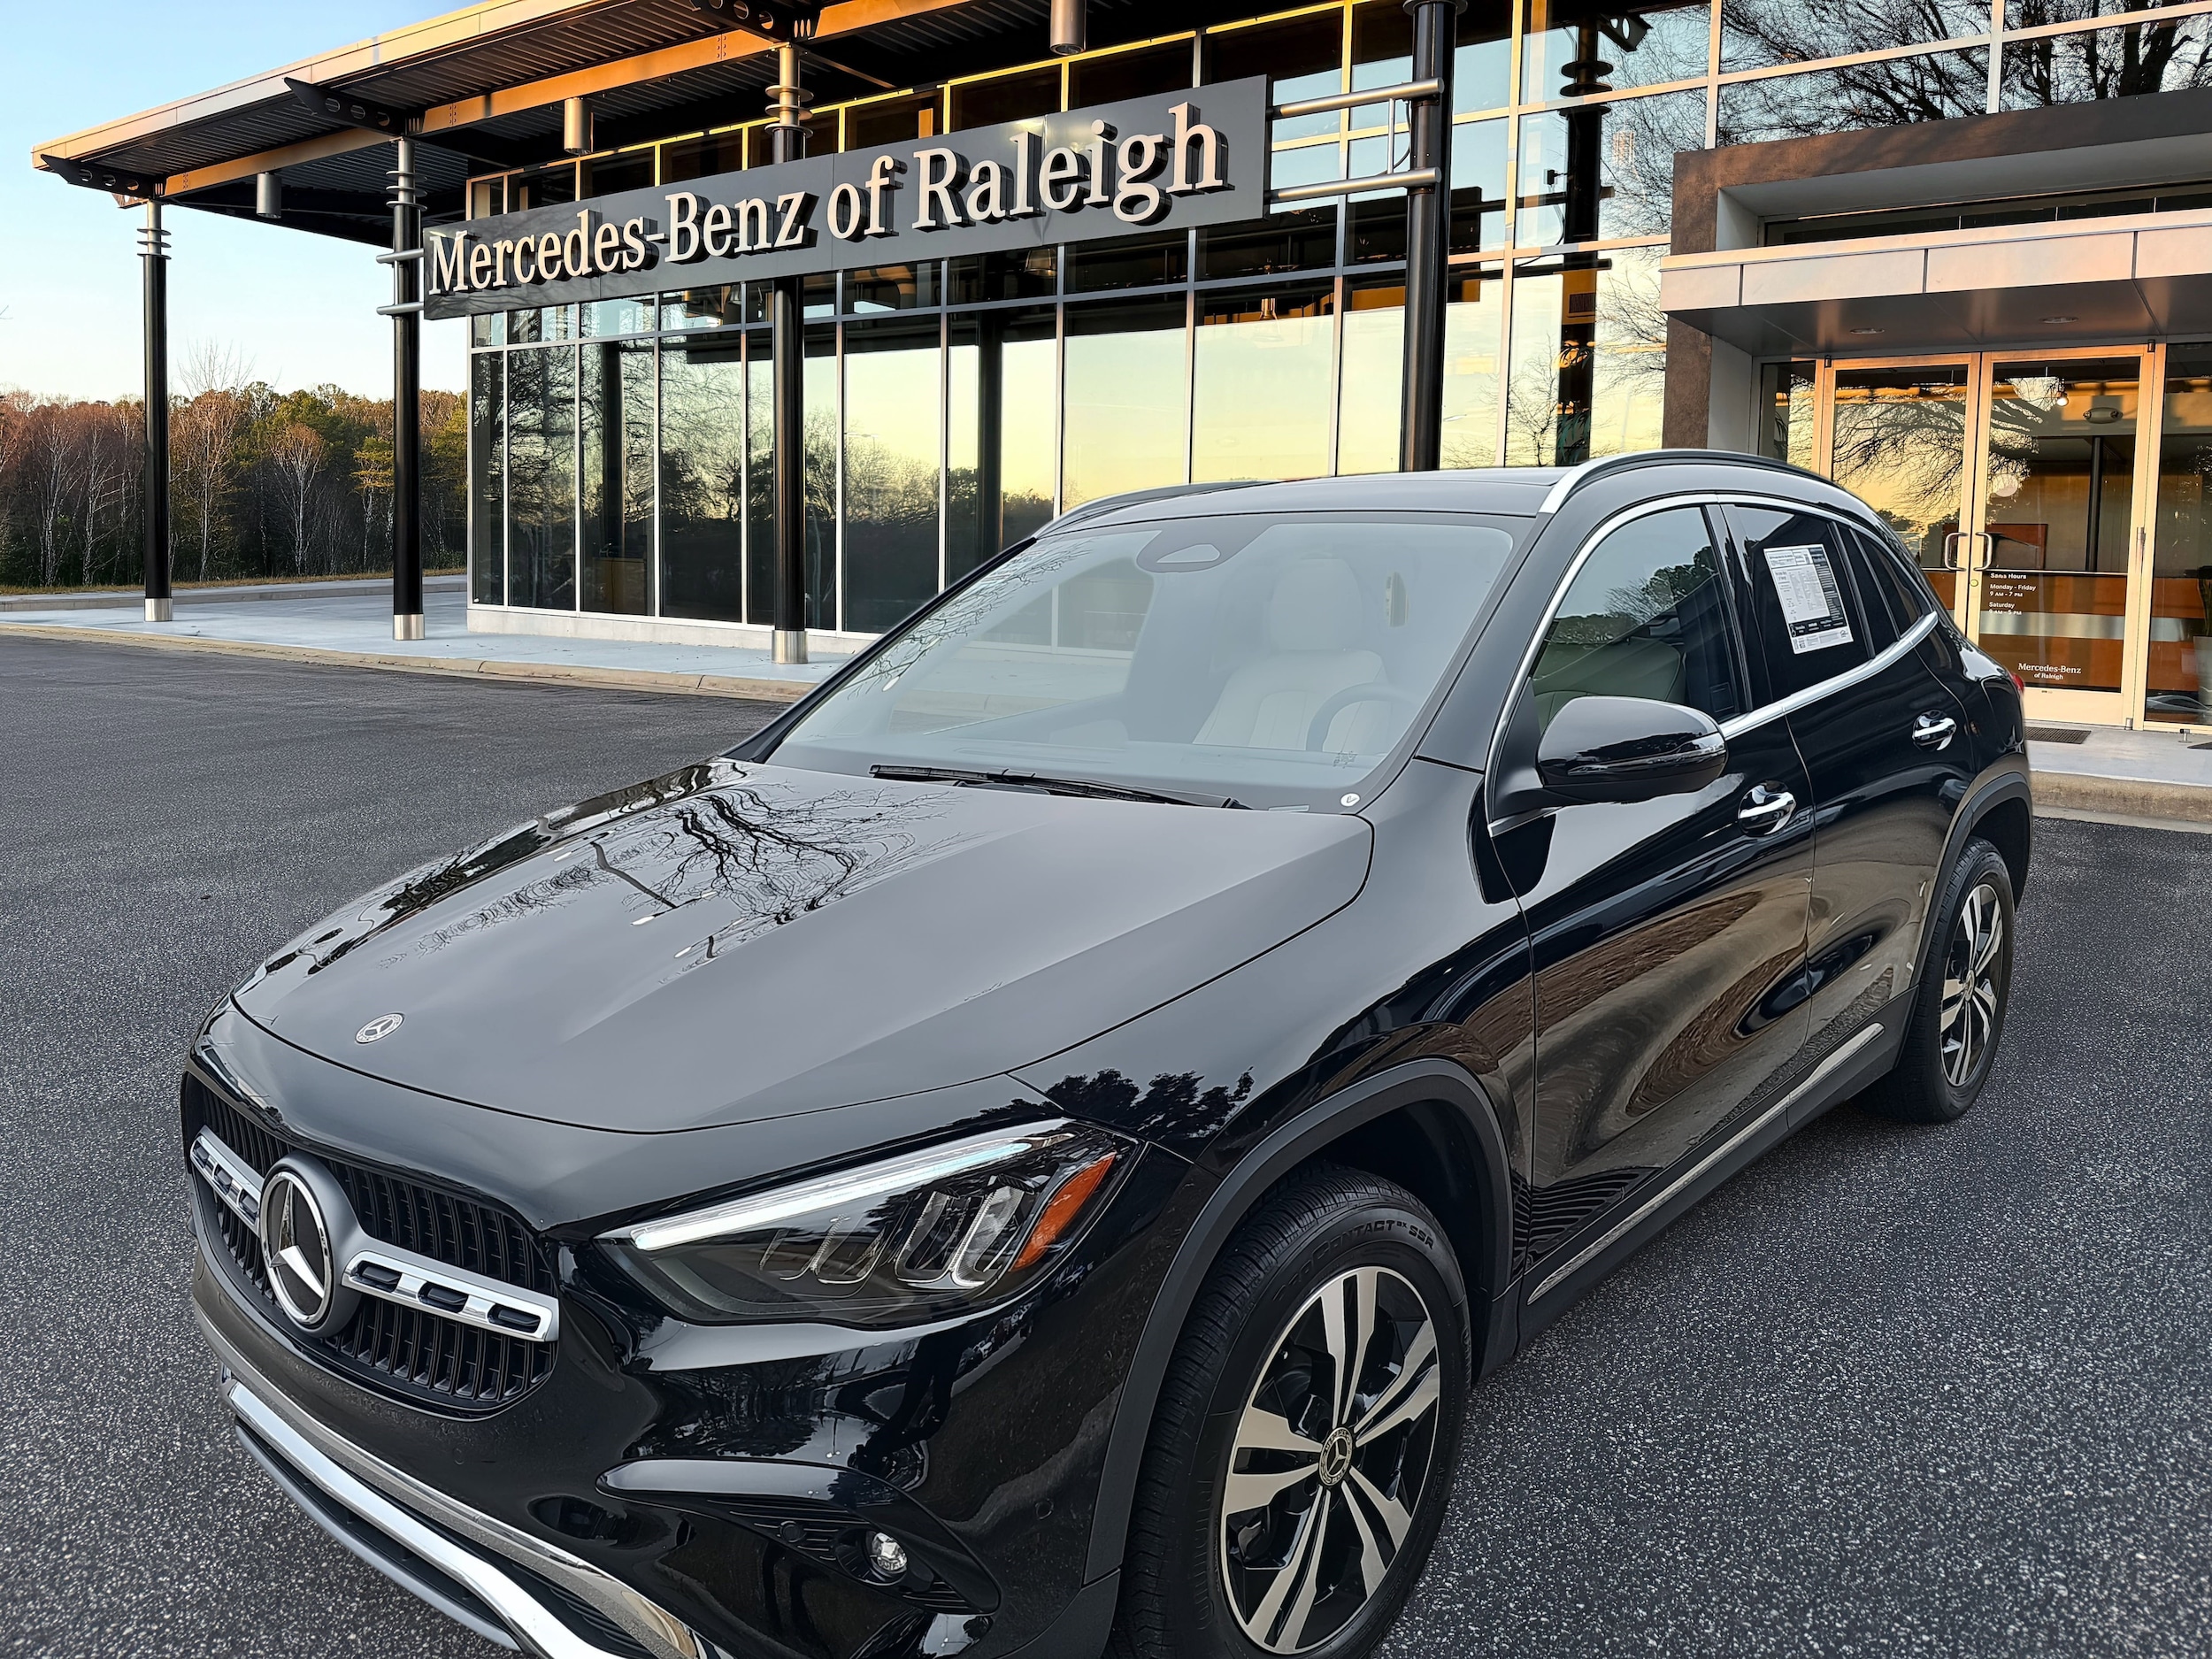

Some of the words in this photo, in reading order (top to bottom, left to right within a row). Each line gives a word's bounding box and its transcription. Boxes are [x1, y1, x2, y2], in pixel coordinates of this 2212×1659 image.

[428, 189, 807, 296] Mercedes-Benz
[827, 154, 897, 240] of
[912, 101, 1225, 223] Raleigh
[2017, 663, 2082, 674] Mercedes-Benz
[1408, 1225, 1434, 1250] SSR
